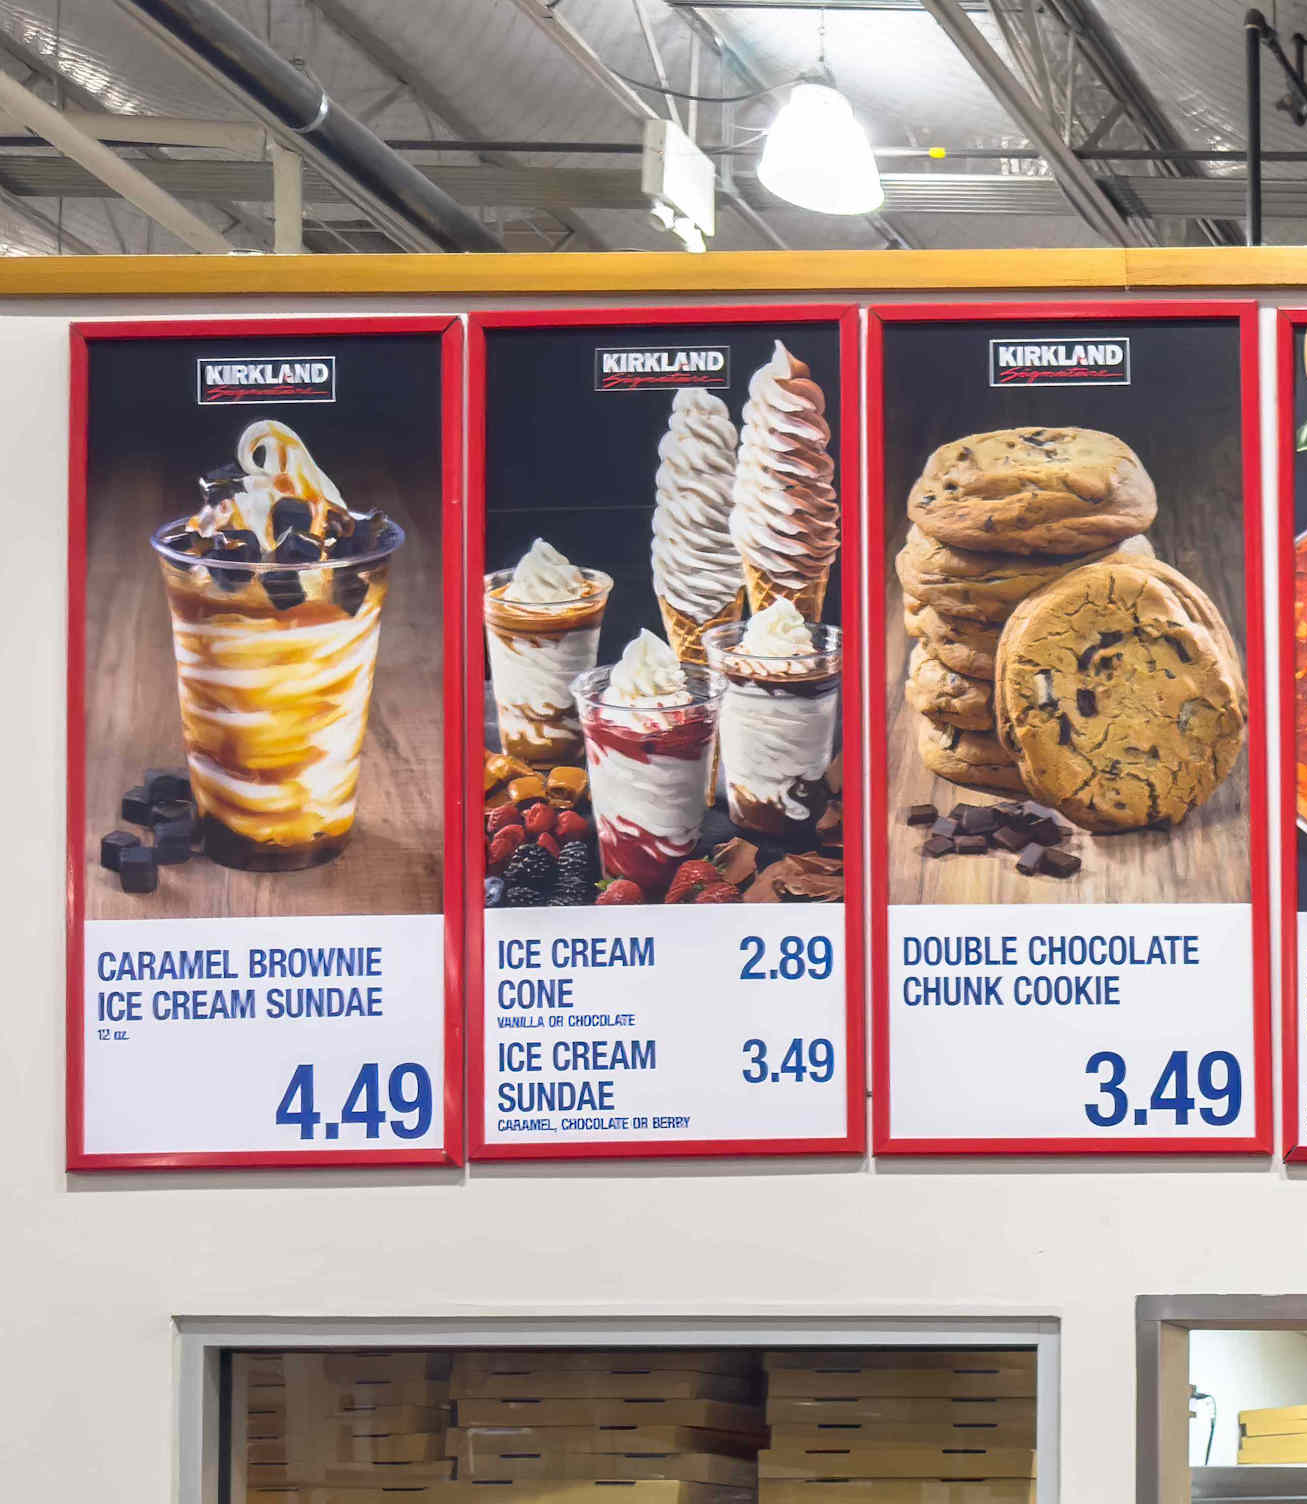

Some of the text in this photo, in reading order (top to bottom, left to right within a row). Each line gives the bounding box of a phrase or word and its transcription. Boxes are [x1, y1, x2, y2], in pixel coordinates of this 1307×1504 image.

[602, 351, 724, 373] KIRKLAND
[999, 345, 1123, 367] KIRKLAND
[206, 363, 329, 385] KIRKLAND
[98, 947, 382, 981] CARAMEL BROWNIE
[499, 937, 654, 969] ICE CREAM
[740, 936, 833, 980] 2.89
[904, 936, 1199, 966] DOUBLE CHOCOLATE
[98, 987, 383, 1021] ICE CREAM SUNDAE
[498, 979, 573, 1009] CONE
[904, 976, 1120, 1006] CHUNK COOKIE
[98, 1029, 110, 1040] 12
[497, 1014, 635, 1028] VANILLA OR CHOCOLATE
[499, 1040, 656, 1072] ICE CREAM
[743, 1038, 834, 1083] 3.49
[276, 1063, 432, 1140] 4.49
[498, 1081, 614, 1112] SUNDAE
[1085, 1051, 1242, 1127] 3.49
[498, 1117, 690, 1132] CARAMEL, CHOCOLATE OR BERRY
